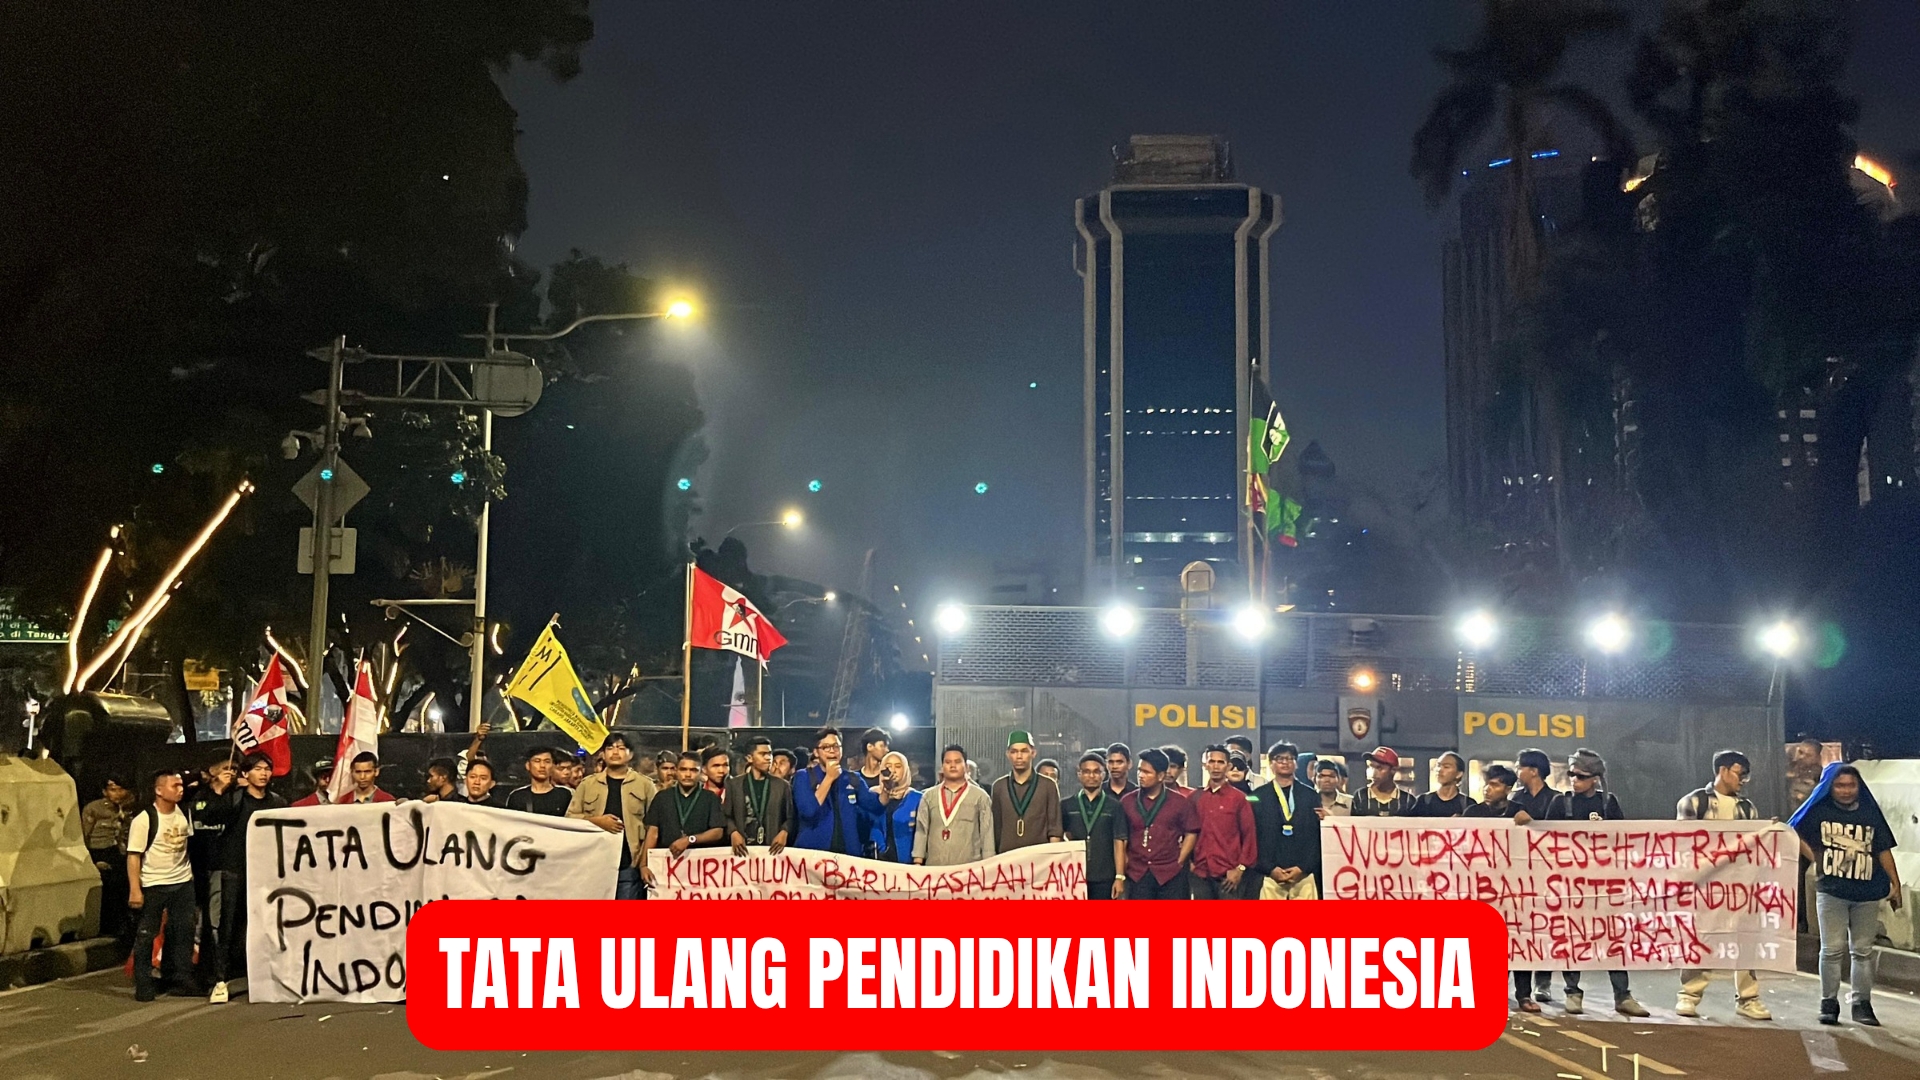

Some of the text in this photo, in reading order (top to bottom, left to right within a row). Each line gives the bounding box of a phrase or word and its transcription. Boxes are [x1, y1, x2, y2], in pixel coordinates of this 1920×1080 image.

[1135, 703, 1258, 730] POLISI
[1463, 711, 1587, 740] POLISI
[255, 808, 546, 879] TATA ULANG
[1333, 825, 1512, 870] WUJUDKAN
[666, 855, 810, 891] KURIKULUM
[906, 864, 1027, 899] MASALAH
[1030, 861, 1088, 895] LAMA
[1427, 870, 1538, 910] RUBAH
[1545, 874, 1656, 911] SISTEM
[1660, 878, 1796, 930] PENDIDIKAN
[1529, 911, 1712, 954] PENDIDIKAN
